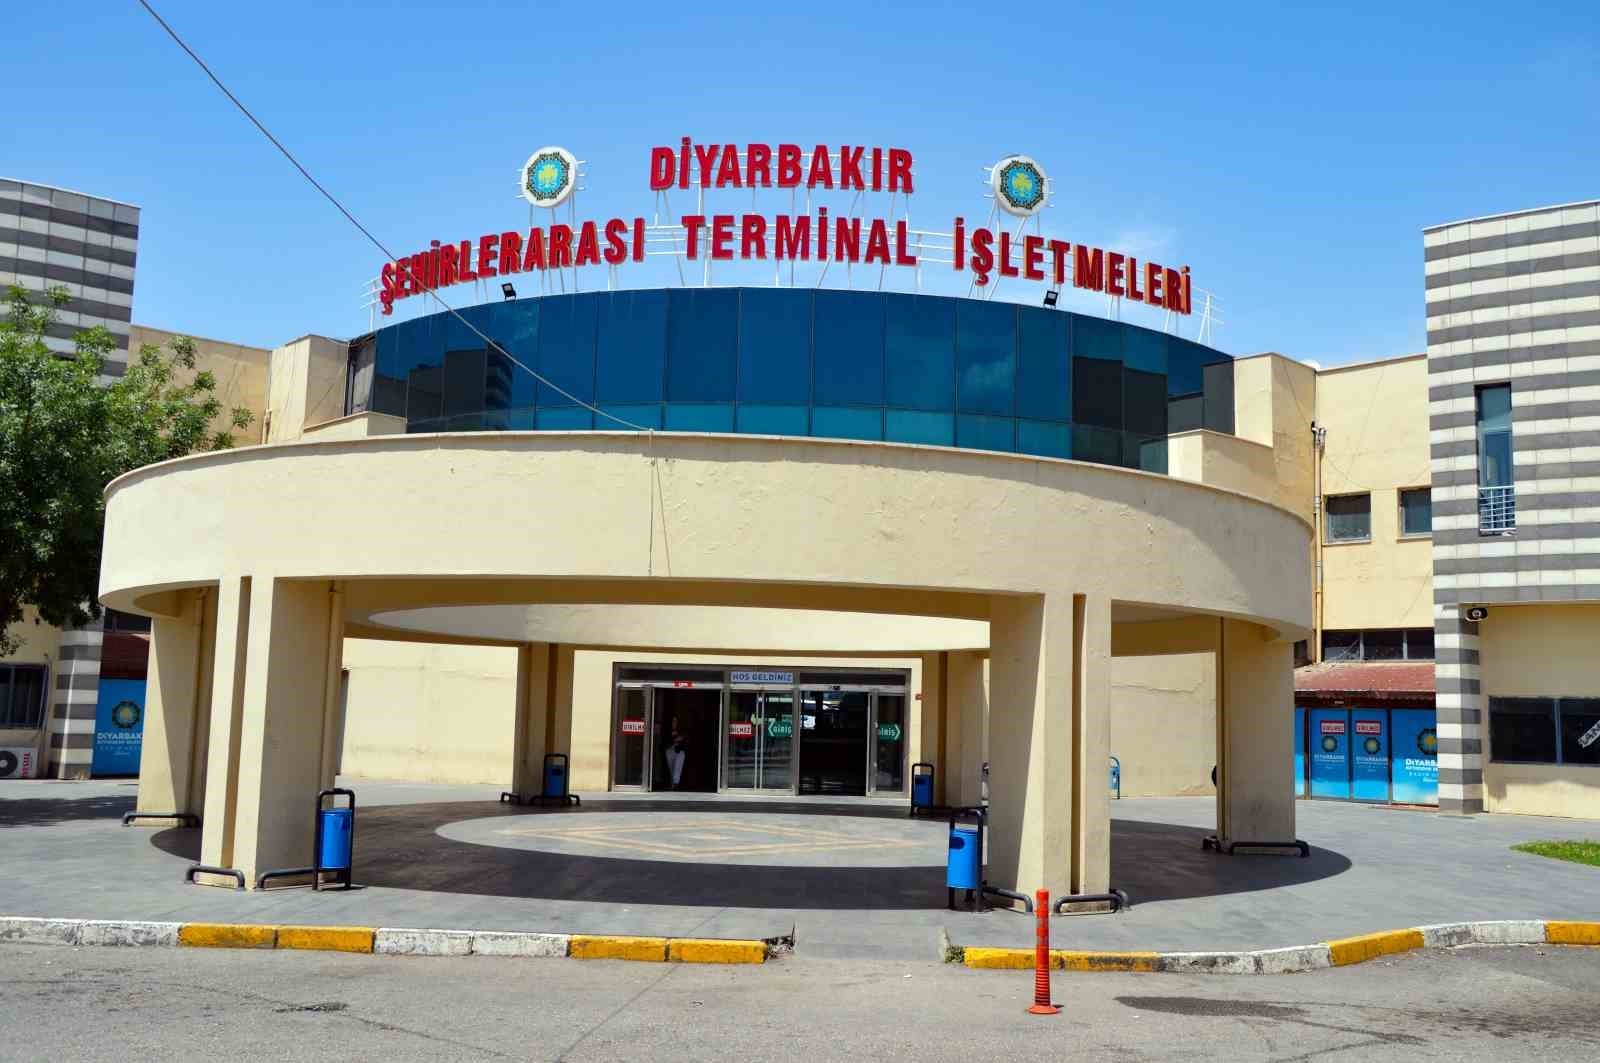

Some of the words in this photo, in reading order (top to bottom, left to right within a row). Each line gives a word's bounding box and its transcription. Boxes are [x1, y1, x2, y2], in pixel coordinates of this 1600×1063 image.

[650, 136, 914, 194] DİYARBAKIR
[379, 217, 646, 315] ŞEHİRLERARASI
[681, 207, 917, 266] TERMİNAL
[952, 217, 1192, 315] İŞLETMELERİ
